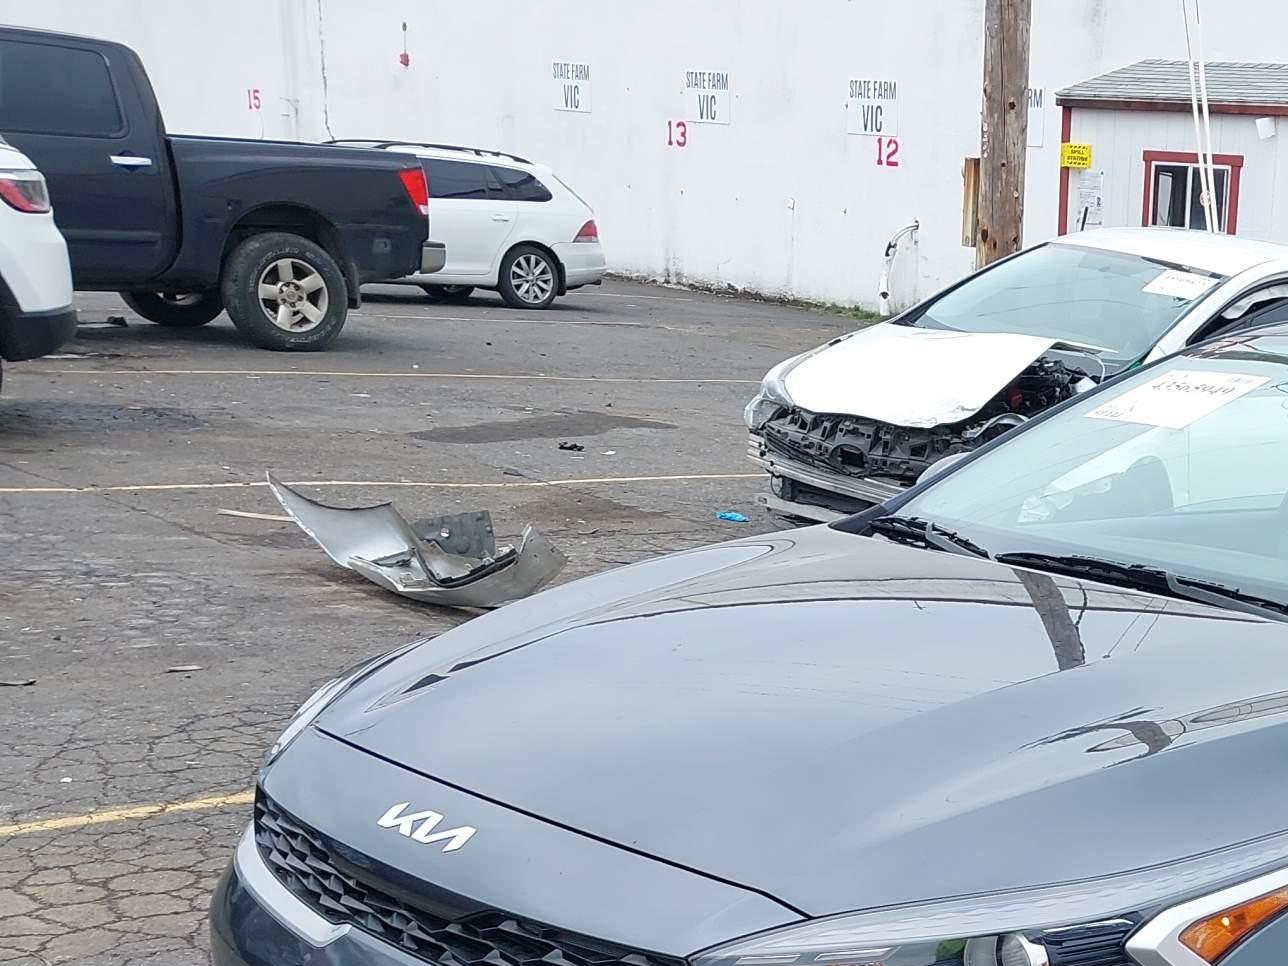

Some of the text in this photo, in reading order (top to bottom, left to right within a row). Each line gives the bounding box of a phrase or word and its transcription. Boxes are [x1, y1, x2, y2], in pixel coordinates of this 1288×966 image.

[553, 62, 590, 81] STATE FARM
[686, 71, 729, 91] STATE FARM
[247, 88, 261, 110] 15
[563, 84, 580, 109] VIC
[849, 79, 897, 100] STATE FARM
[1026, 88, 1043, 108] RM
[698, 94, 717, 120] VIC
[862, 104, 883, 133] VIC
[667, 120, 687, 147] 13
[876, 137, 899, 167] 12
[376, 801, 478, 854] KIA
